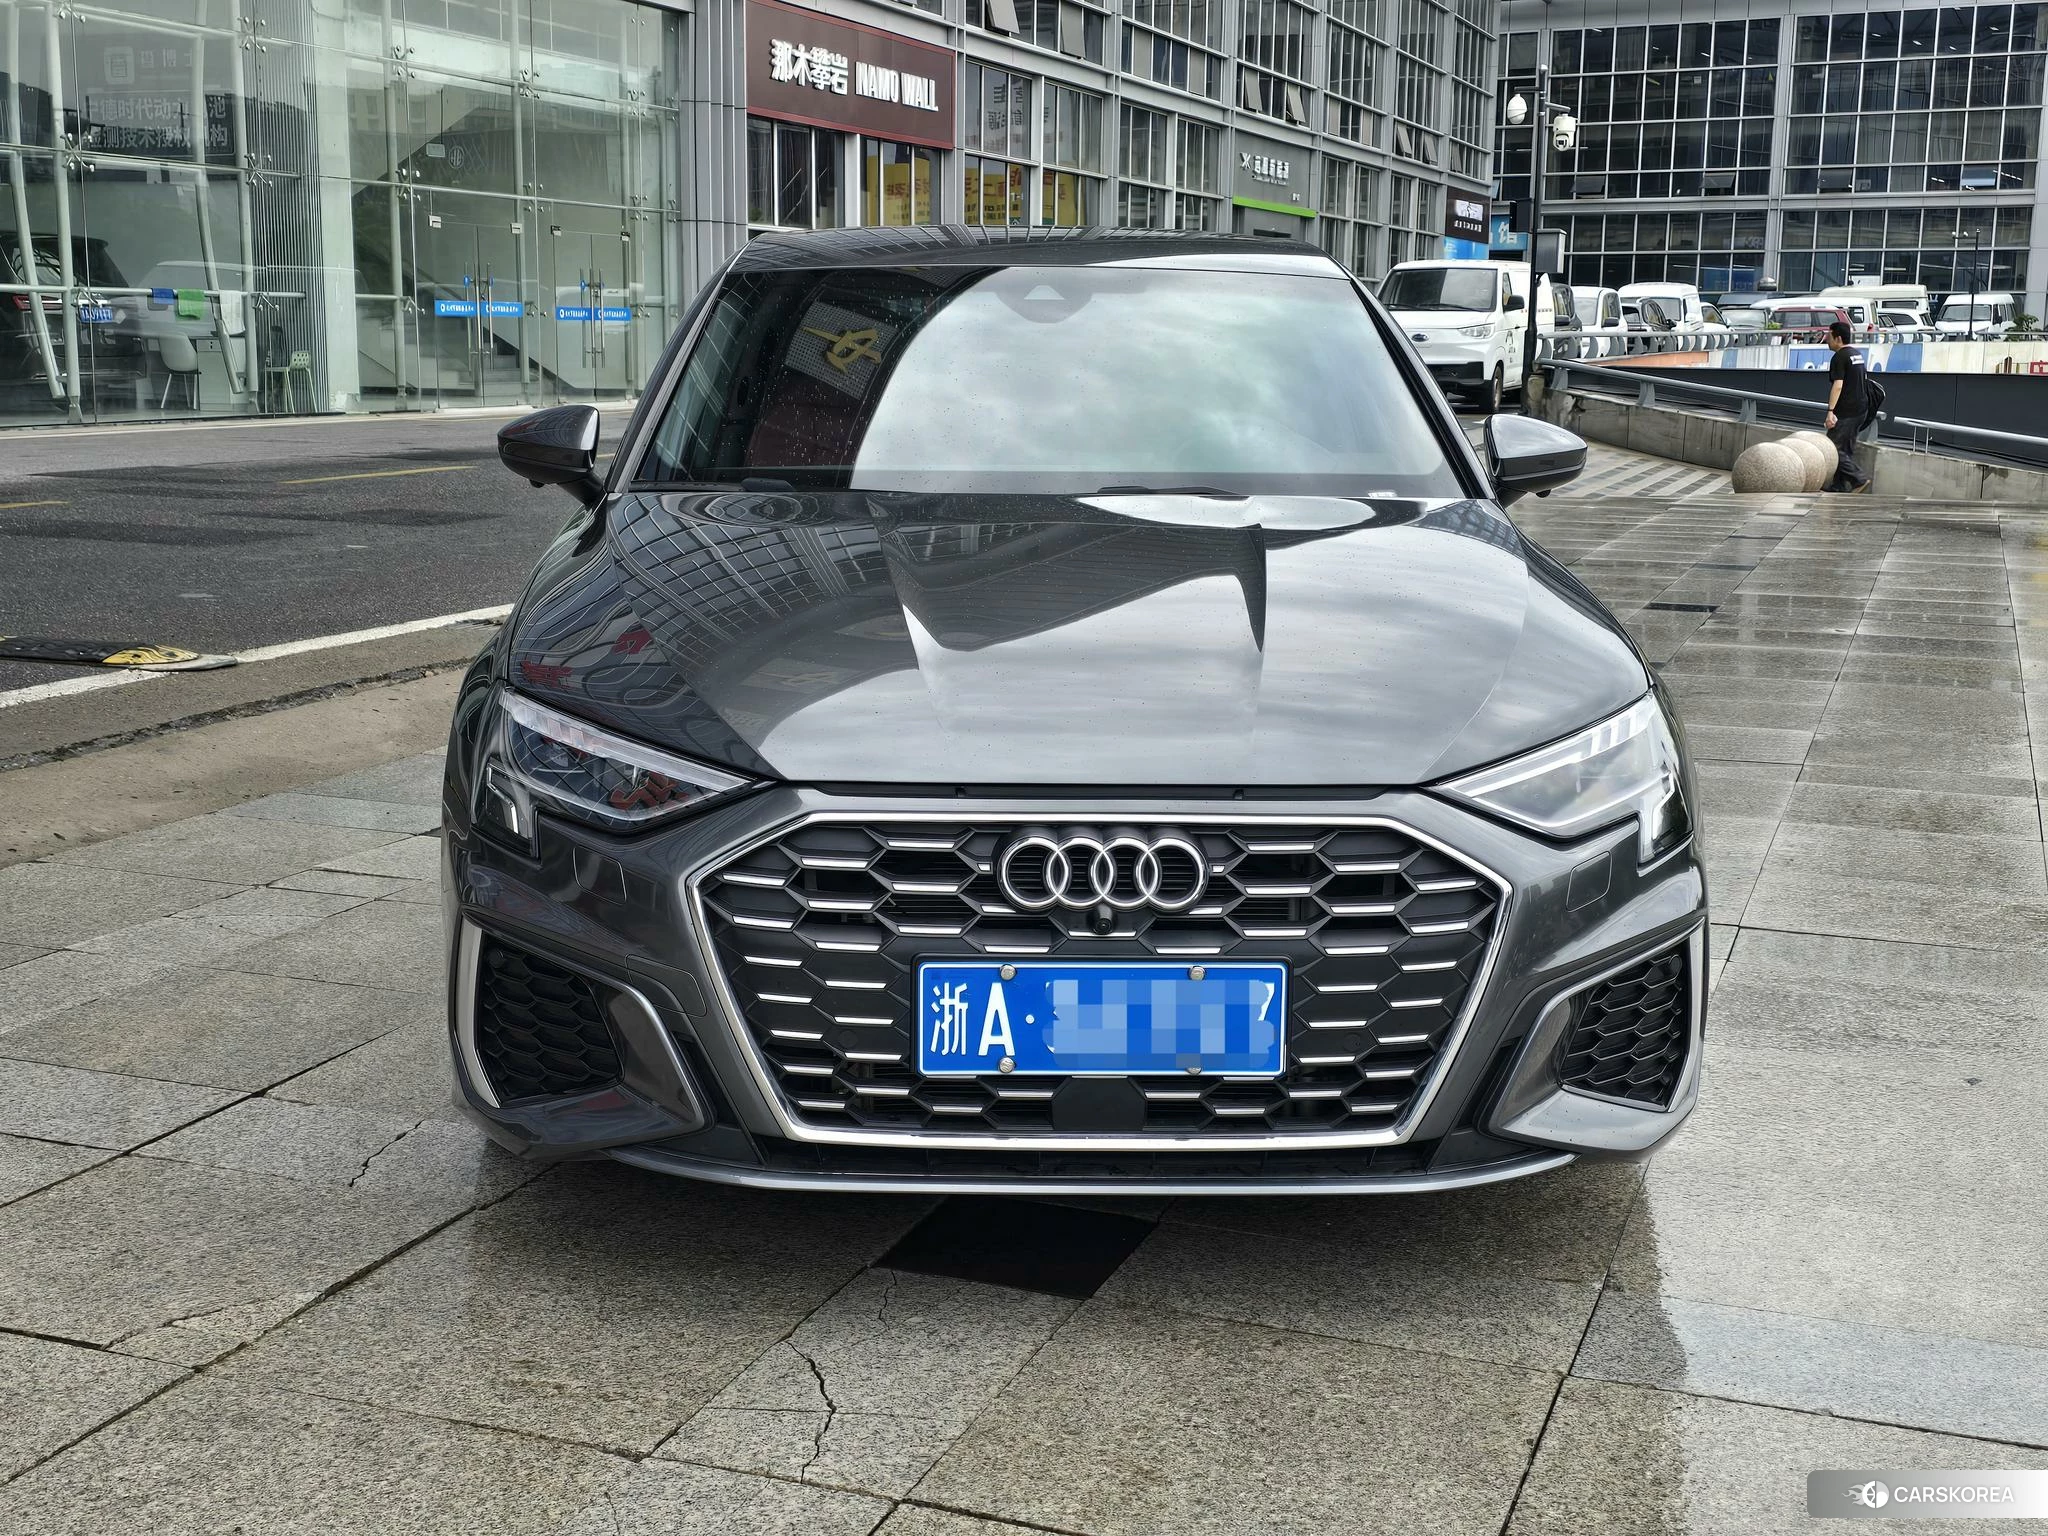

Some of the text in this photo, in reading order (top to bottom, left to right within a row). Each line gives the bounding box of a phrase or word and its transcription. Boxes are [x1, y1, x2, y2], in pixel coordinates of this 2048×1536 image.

[772, 39, 939, 111] 那木攀岩 NAMO WALL
